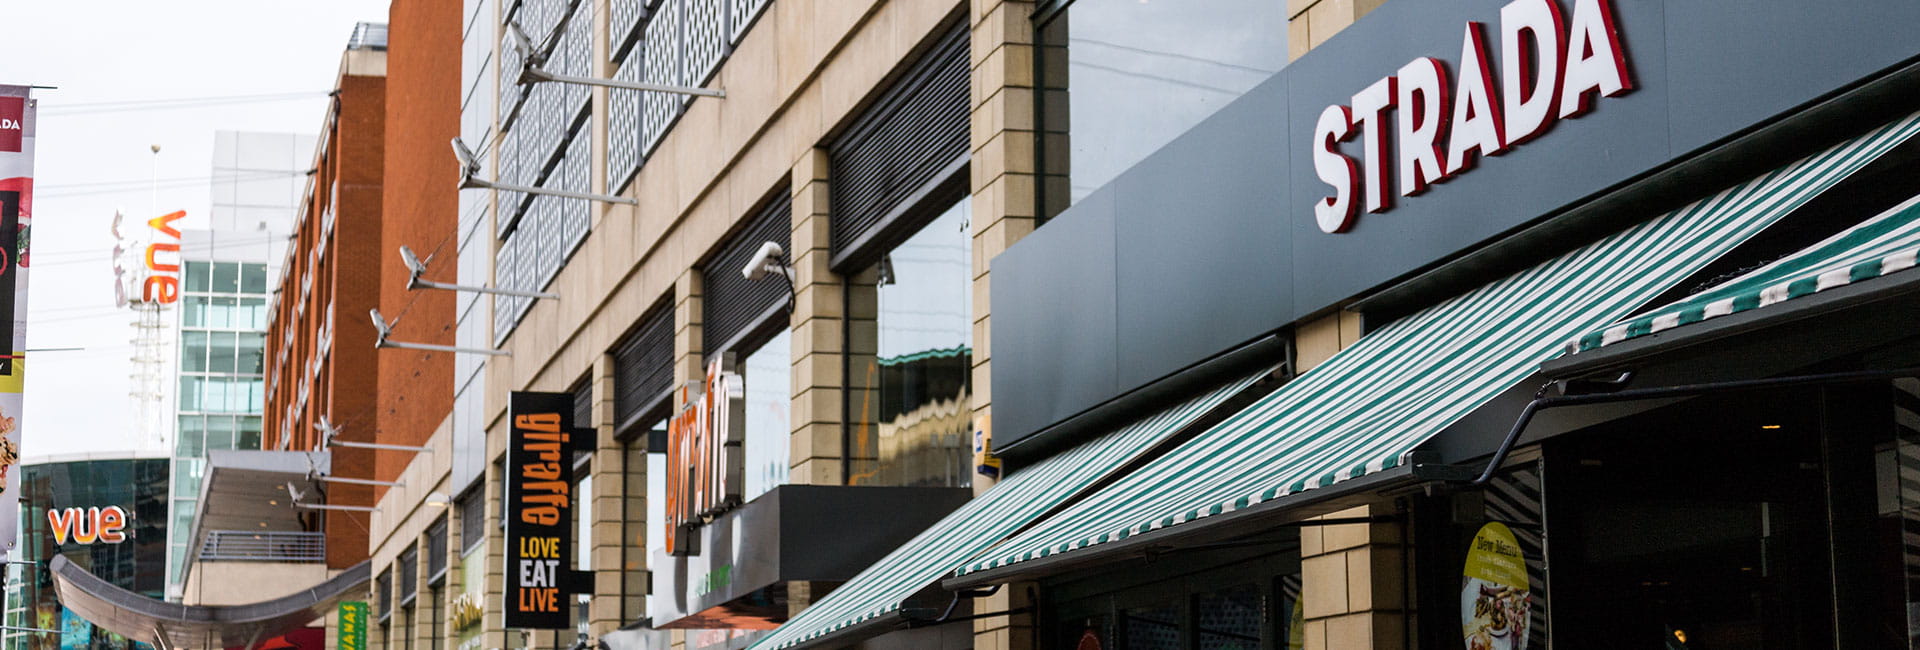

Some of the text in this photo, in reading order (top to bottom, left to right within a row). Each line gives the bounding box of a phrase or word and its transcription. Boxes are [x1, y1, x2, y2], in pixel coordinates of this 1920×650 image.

[0, 119, 20, 130] DA
[1312, 0, 1632, 234] STRADA
[143, 209, 186, 304] vue
[515, 413, 570, 526] giraffe
[48, 505, 126, 545] vue
[520, 536, 560, 558] LOVE
[519, 560, 560, 587] EAT
[519, 588, 559, 612] LIVE
